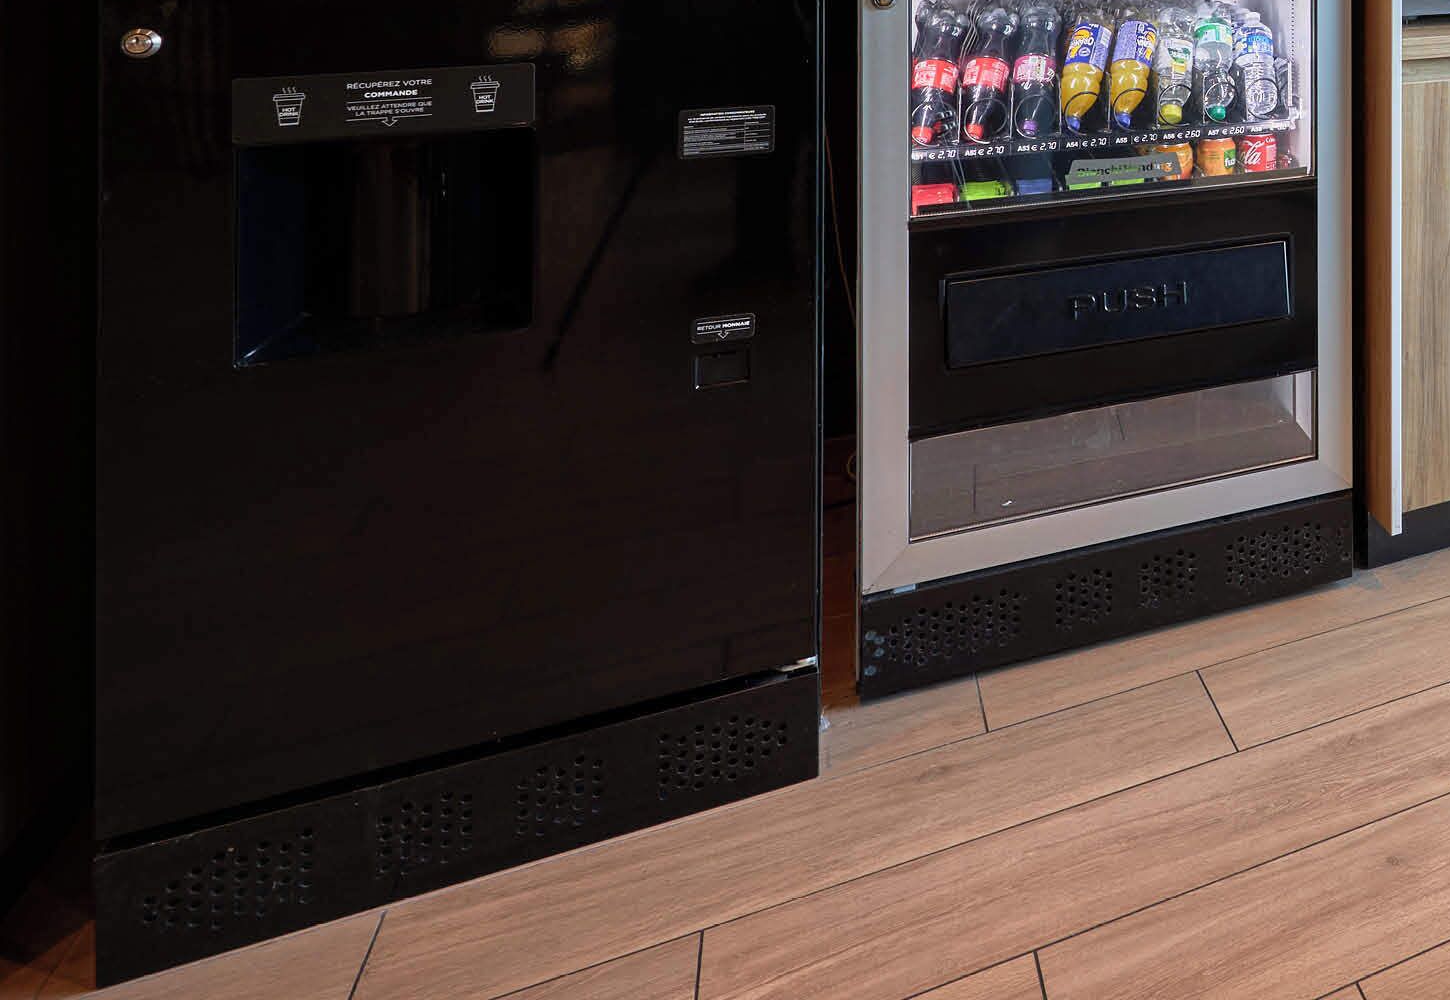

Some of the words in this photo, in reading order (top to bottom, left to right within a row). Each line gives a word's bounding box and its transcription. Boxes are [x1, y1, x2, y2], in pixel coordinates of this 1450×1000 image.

[346, 79, 400, 90] RÉCUPÉREZ
[402, 78, 433, 87] VOTRE
[364, 89, 419, 99] COMMANDE
[381, 101, 417, 110] ATTENDRE
[1208, 128, 1220, 136] A57
[1065, 140, 1079, 148] A54
[1068, 280, 1188, 321] PUSH
